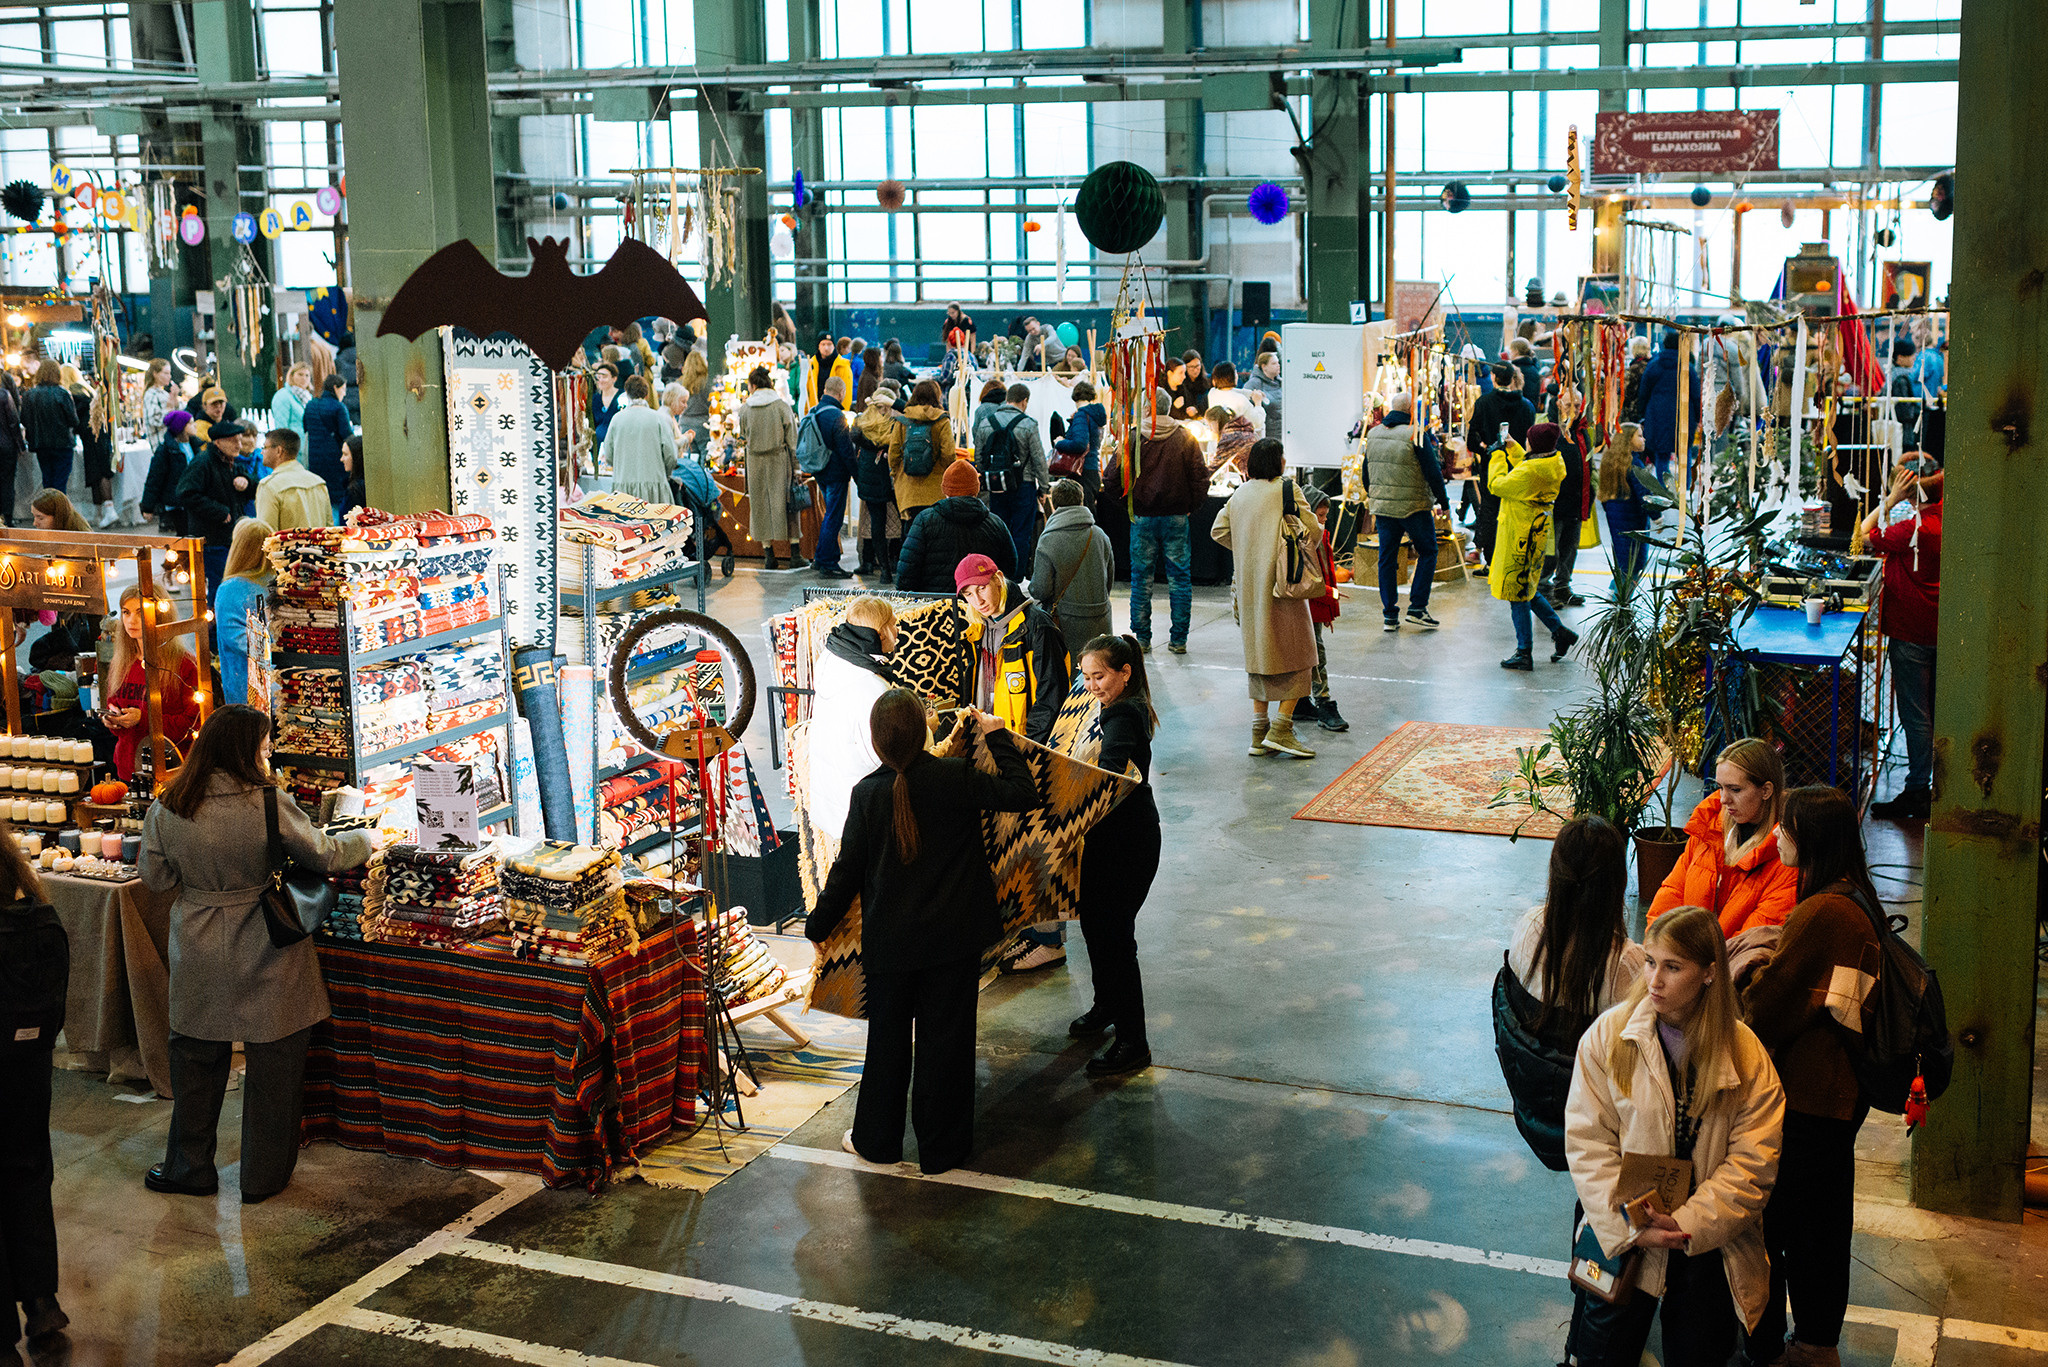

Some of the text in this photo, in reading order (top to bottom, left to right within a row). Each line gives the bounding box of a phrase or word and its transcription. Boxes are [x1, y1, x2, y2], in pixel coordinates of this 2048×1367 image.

[1632, 129, 1741, 142] ИНТЕЛЛИГЕНТНАЯ
[1651, 142, 1722, 153] БАРАХОЛКА
[52, 166, 200, 242] МАСЕР
[18, 571, 82, 588] ART LAB 7.1
